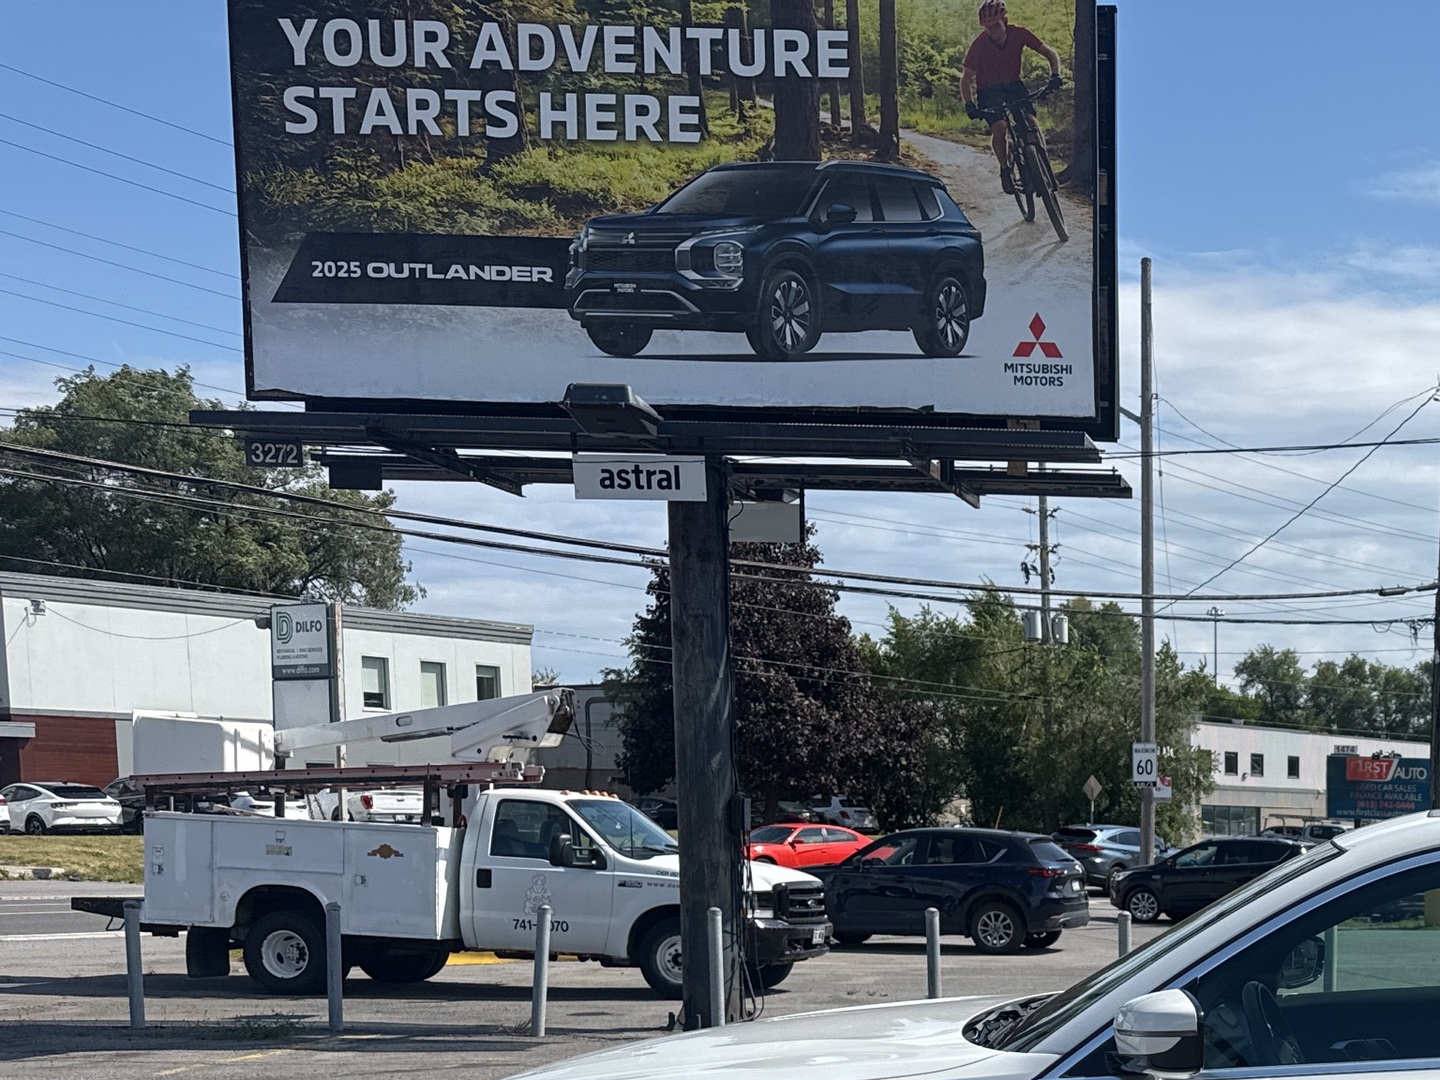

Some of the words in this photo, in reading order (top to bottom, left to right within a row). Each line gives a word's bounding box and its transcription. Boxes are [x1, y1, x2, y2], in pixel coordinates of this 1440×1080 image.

[277, 17, 452, 68] YOUR
[469, 22, 851, 78] ADVENTURE
[283, 86, 518, 138] STARTS
[540, 92, 700, 143] HERE
[311, 261, 361, 278] 2025
[367, 262, 554, 283] OUTLANDER
[1004, 363, 1073, 375] MITSUBISHI
[1014, 376, 1064, 387] MOTORS
[251, 442, 298, 464] 3272
[600, 464, 681, 490] astral
[296, 620, 323, 633] DILFO
[1136, 759, 1153, 775] 60
[1394, 767, 1428, 780] AUTO
[1395, 784, 1417, 792] SALES
[1384, 793, 1423, 801] AVAILABLE
[513, 918, 569, 932] 741-70
